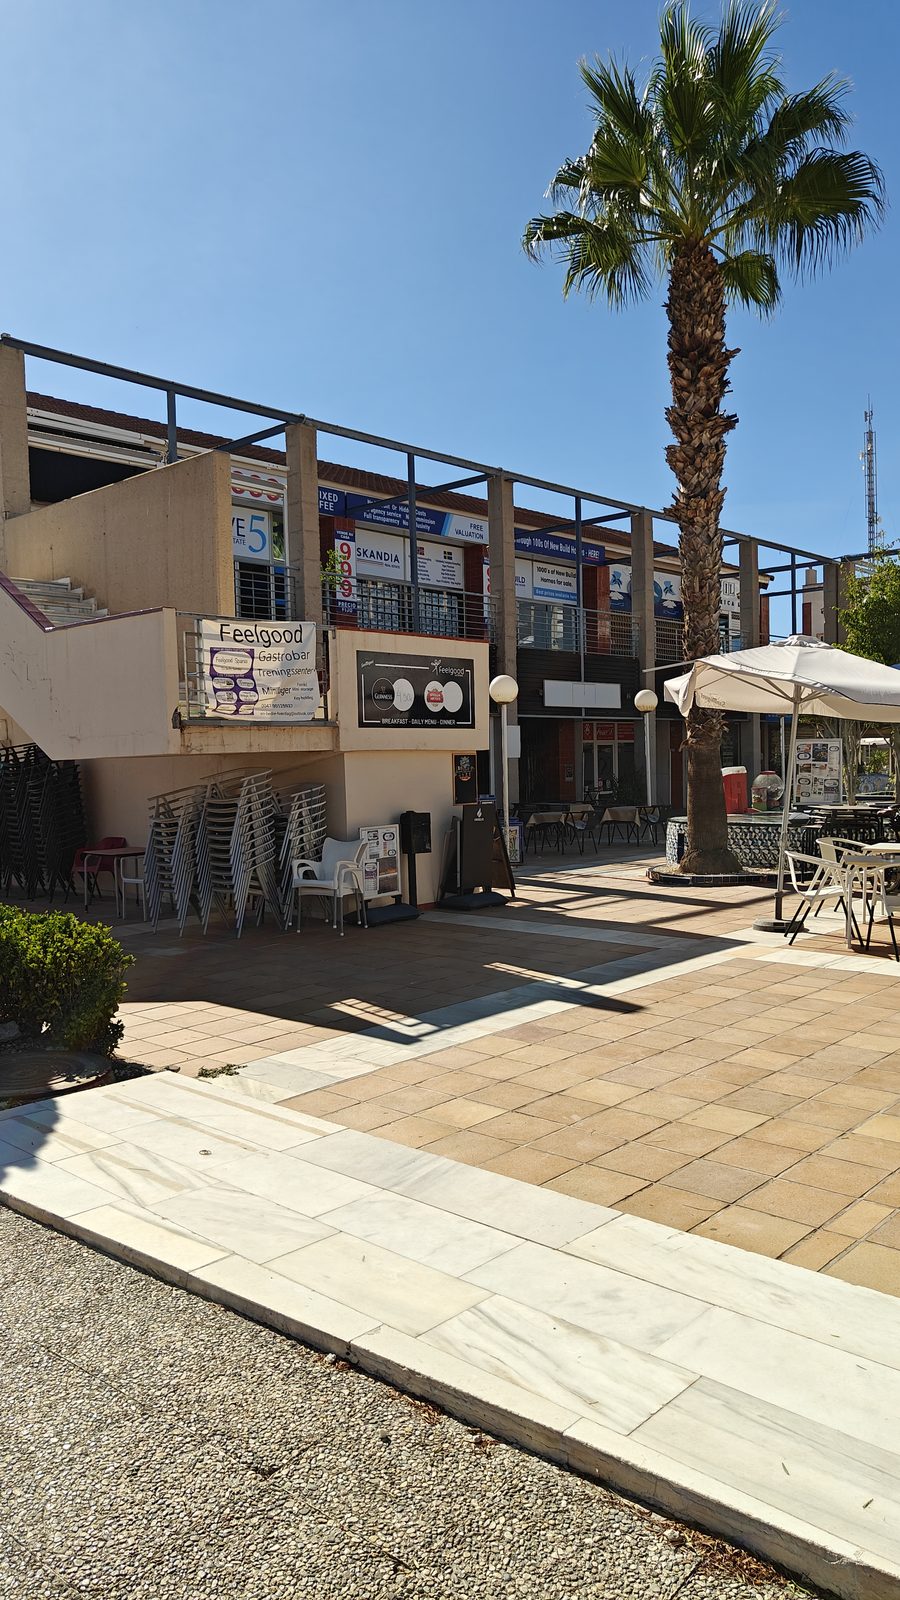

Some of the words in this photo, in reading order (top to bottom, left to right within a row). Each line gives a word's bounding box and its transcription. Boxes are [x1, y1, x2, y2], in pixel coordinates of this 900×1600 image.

[319, 491, 338, 502] IXED
[319, 501, 334, 511] FEE
[470, 523, 483, 531] FREE
[248, 514, 267, 553] 5
[454, 528, 484, 540] VALUATION
[233, 538, 246, 546] TATE
[532, 538, 543, 548] 100s
[544, 540, 550, 549] Of
[550, 541, 560, 550] New
[560, 543, 571, 554] Build
[356, 547, 400, 564] SKANDIA
[541, 577, 556, 585] Homes
[220, 624, 303, 648] Feelgood
[258, 650, 310, 662] Gastrobar
[439, 666, 465, 675] Feelgood
